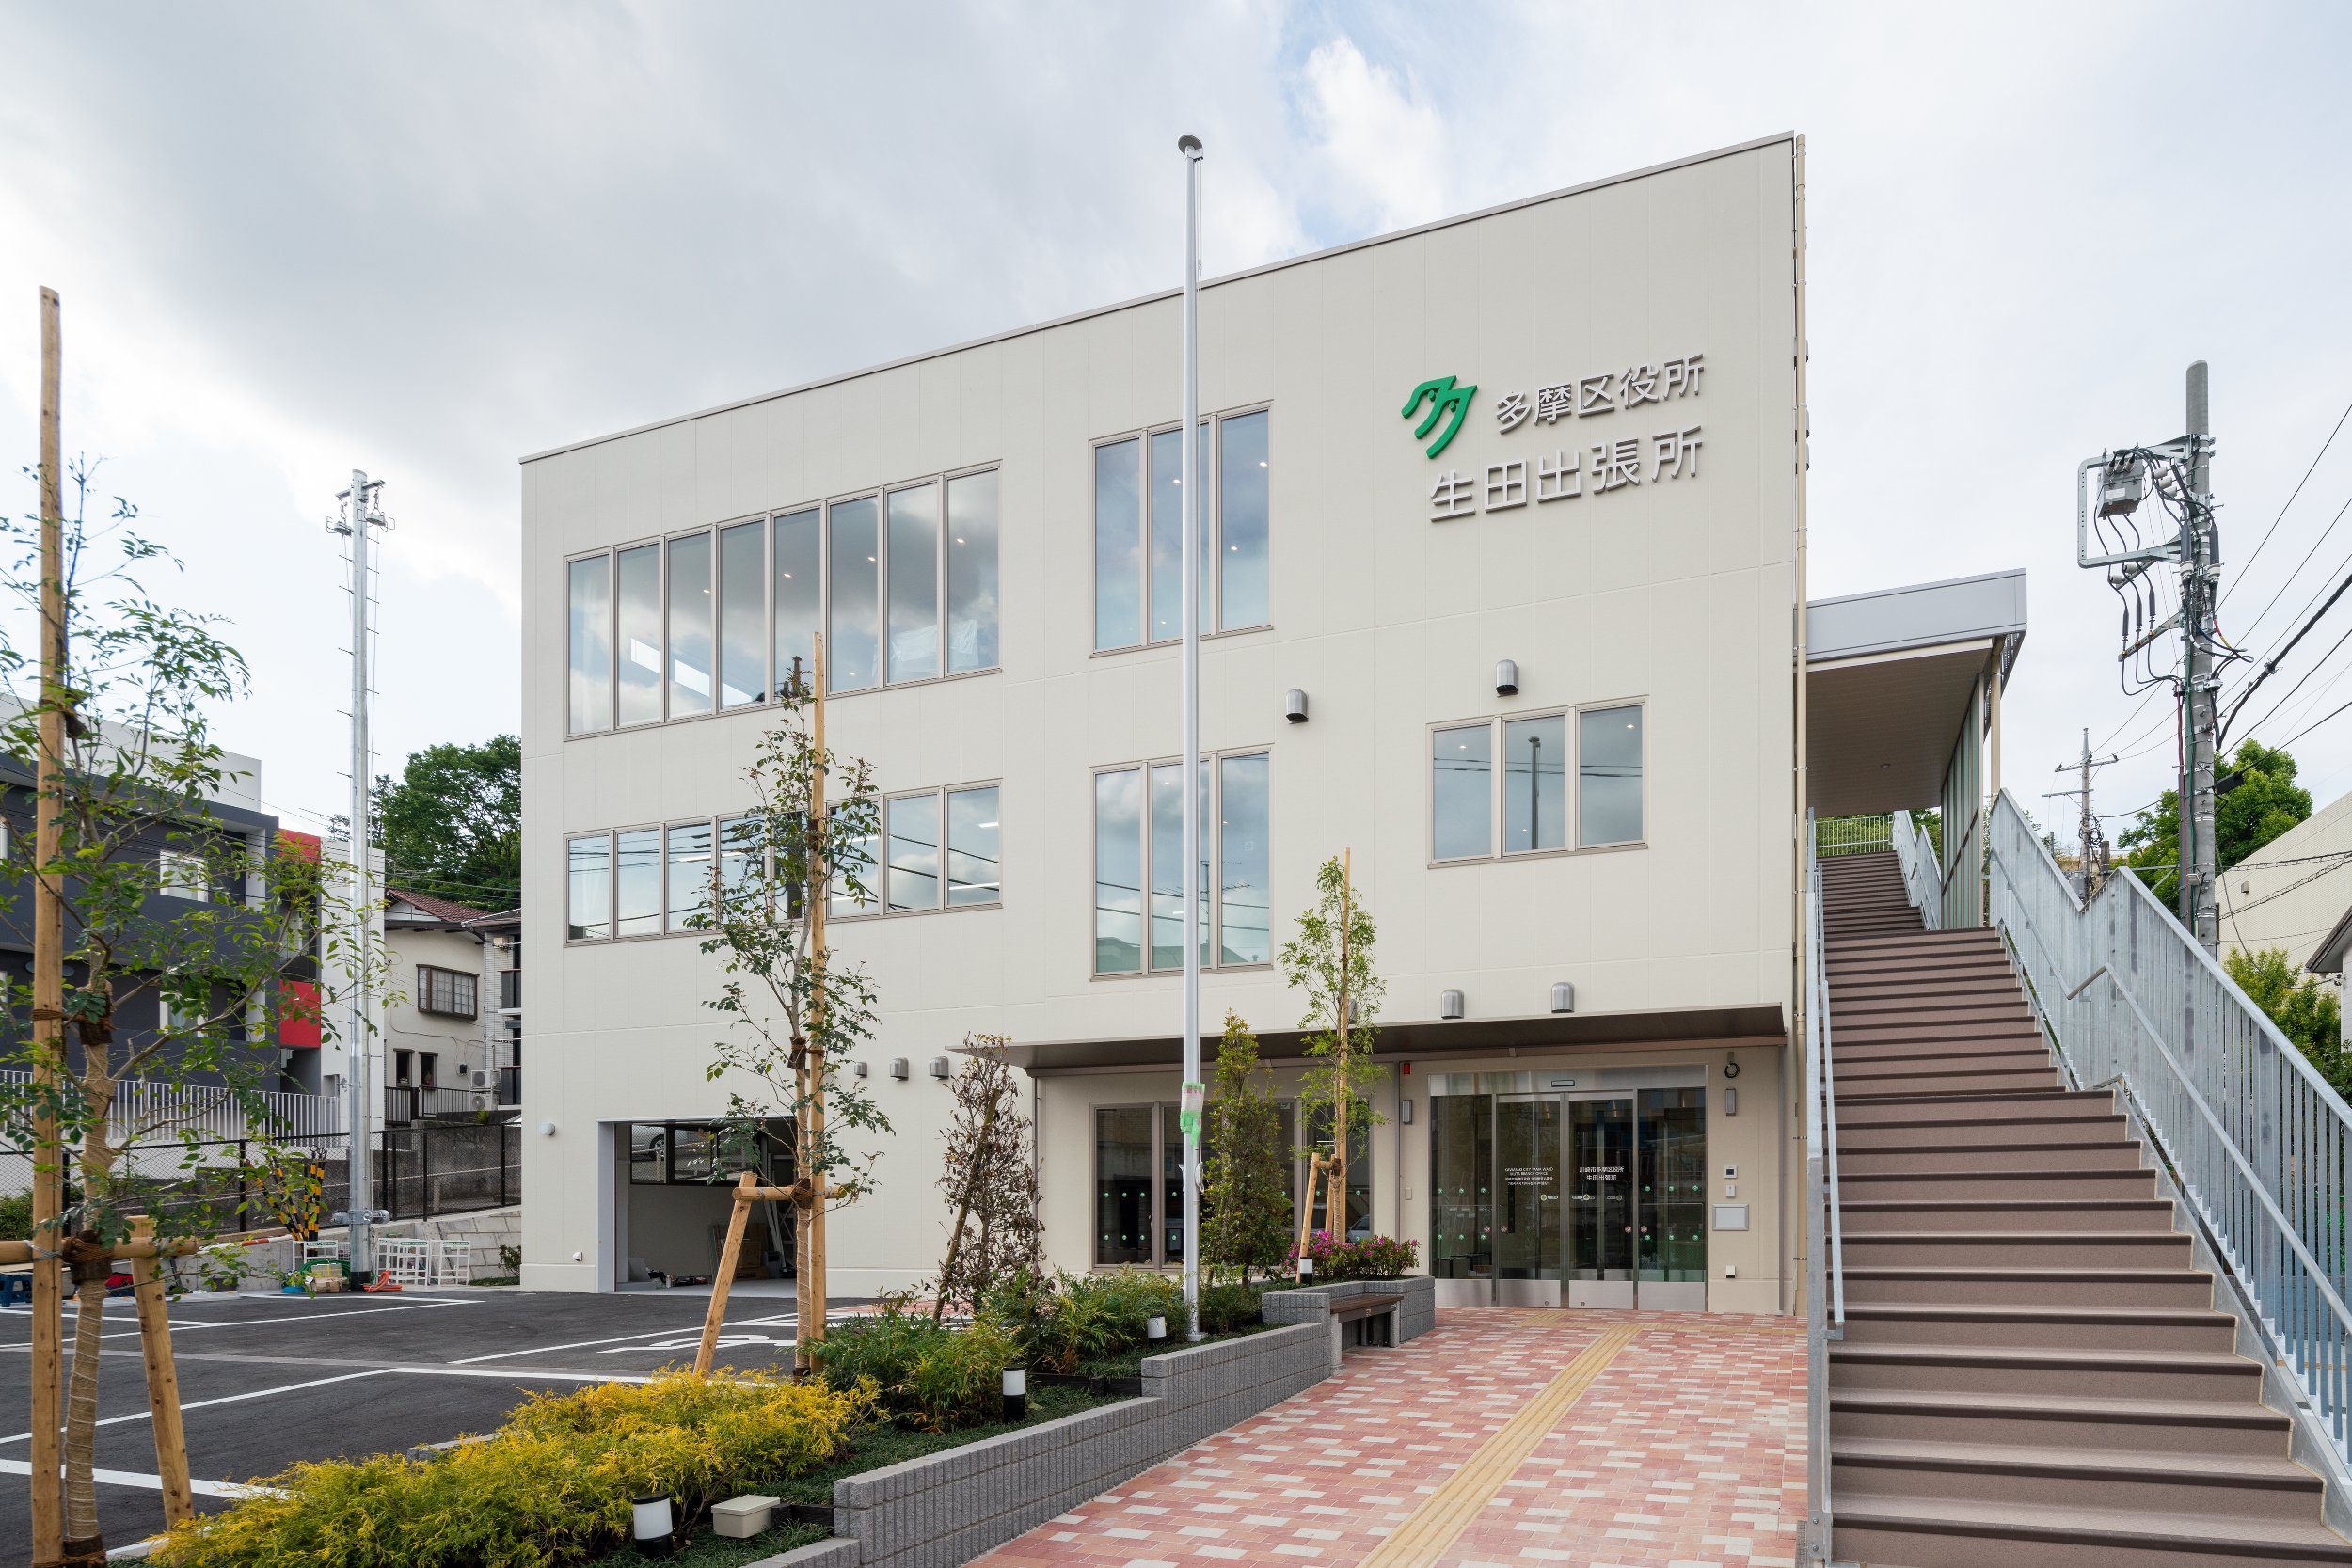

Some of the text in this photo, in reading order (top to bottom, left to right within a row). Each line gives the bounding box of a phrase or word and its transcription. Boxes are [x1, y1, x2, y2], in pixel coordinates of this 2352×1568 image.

[1496, 353, 1705, 435] 多摩区役所
[1429, 424, 1703, 523] 生田出張所
